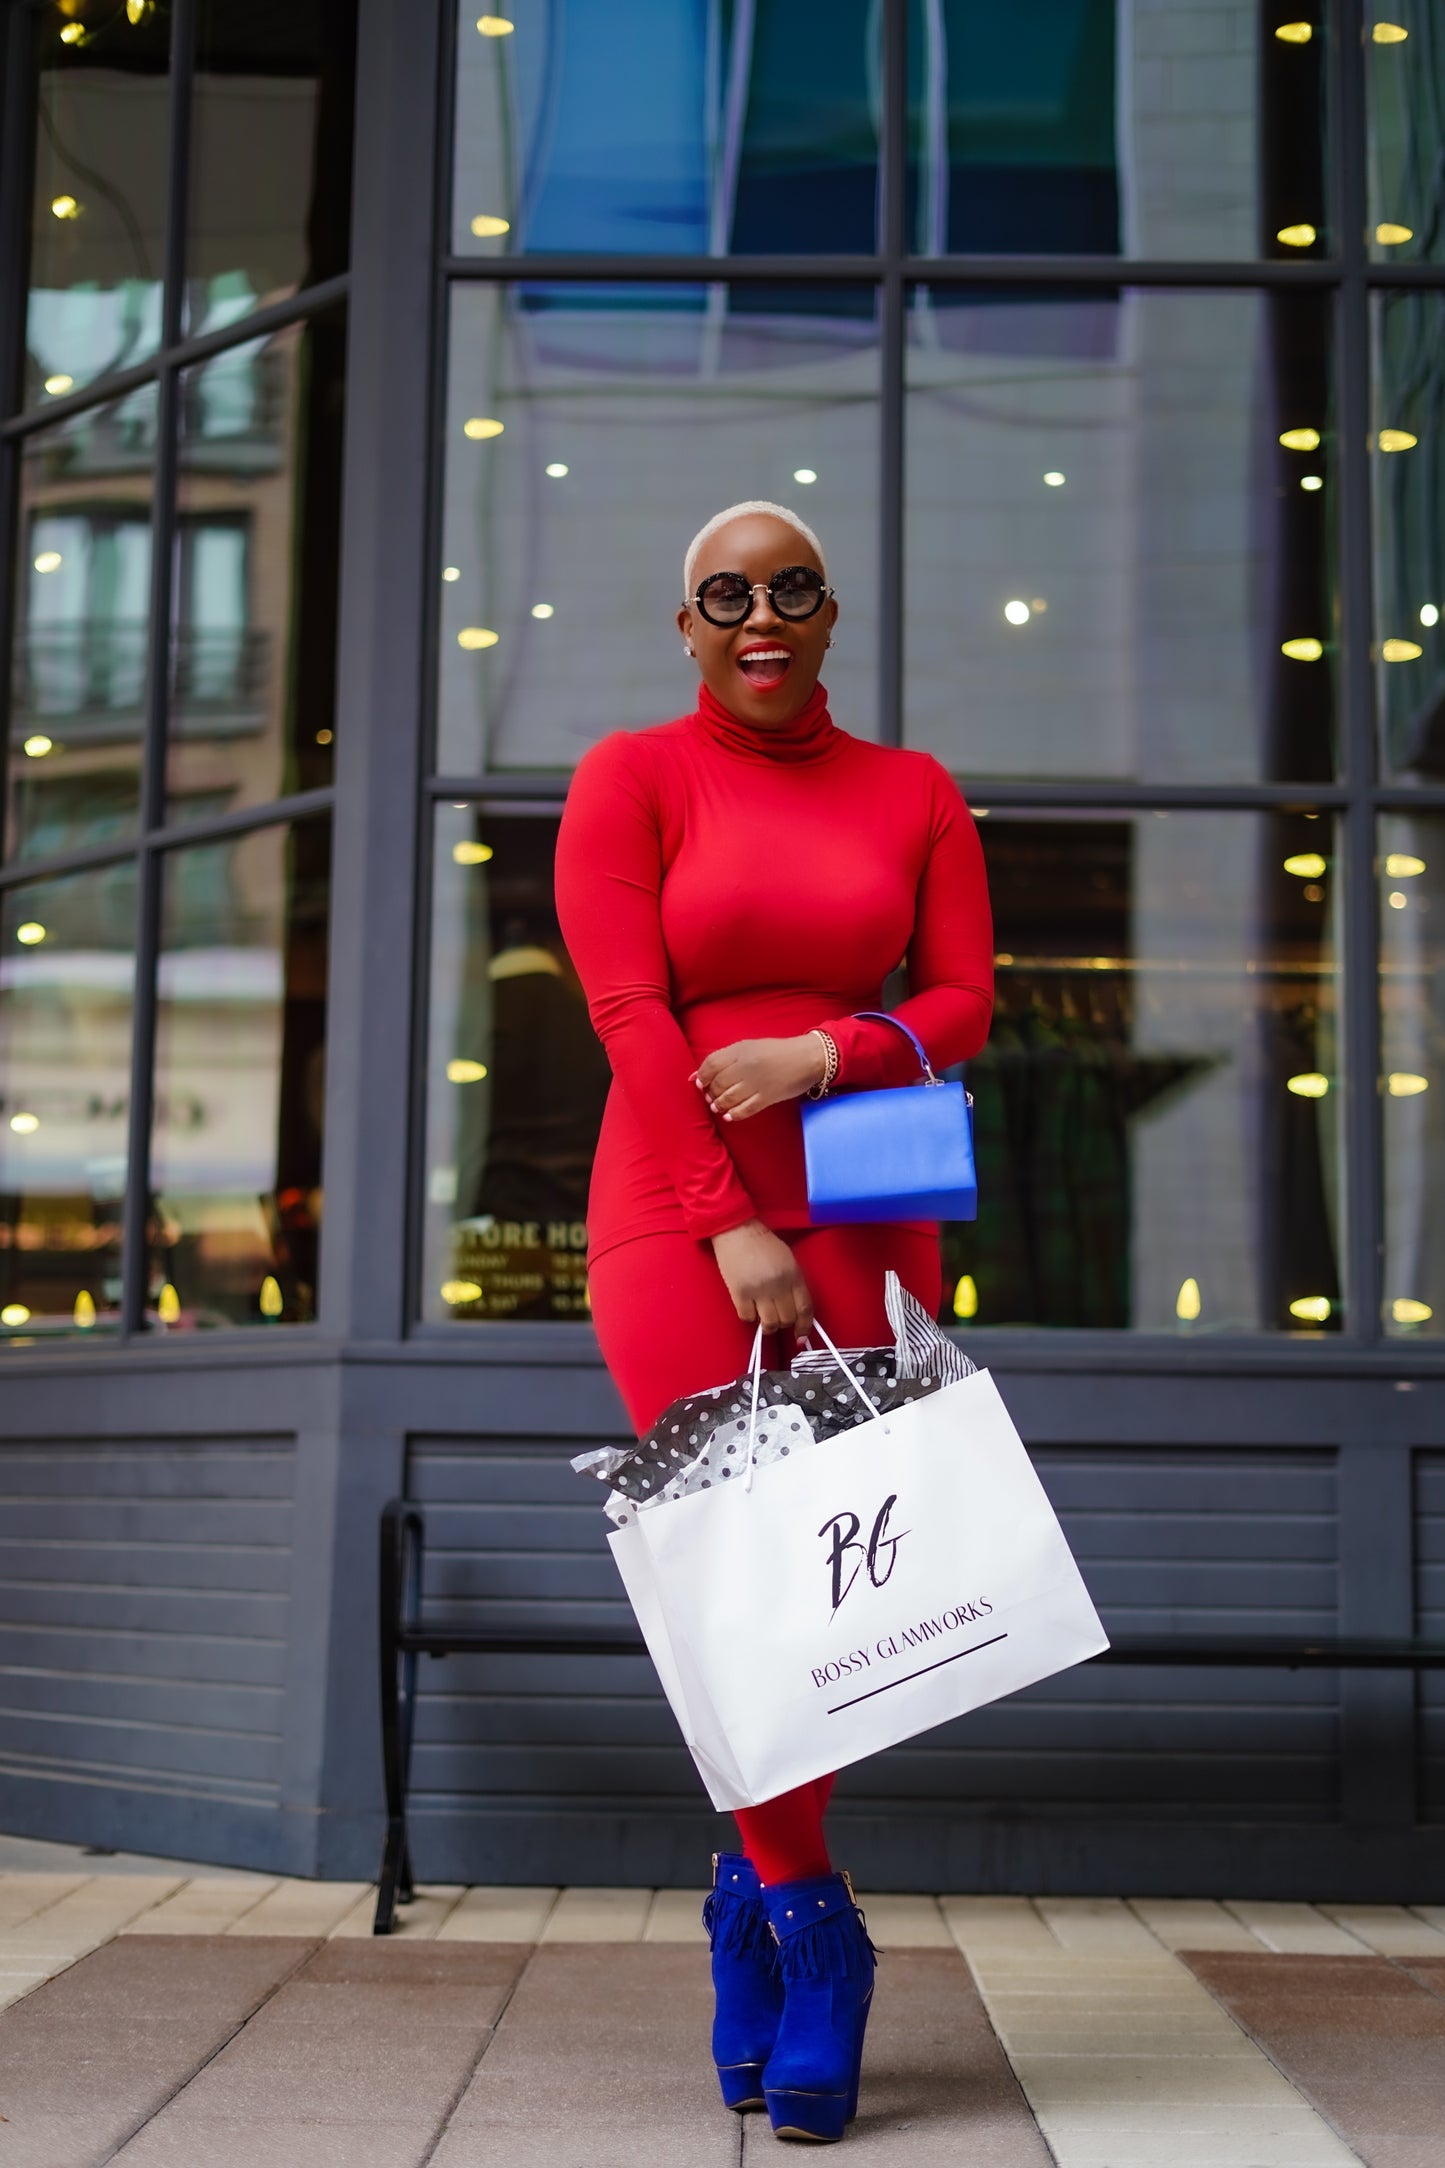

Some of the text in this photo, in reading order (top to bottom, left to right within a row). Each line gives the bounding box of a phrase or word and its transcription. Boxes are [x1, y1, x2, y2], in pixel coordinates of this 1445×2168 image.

[548, 1222, 588, 1248] HO
[817, 1494, 912, 1627] BG
[811, 1596, 993, 1688] BOSSY GLAMWORKS
